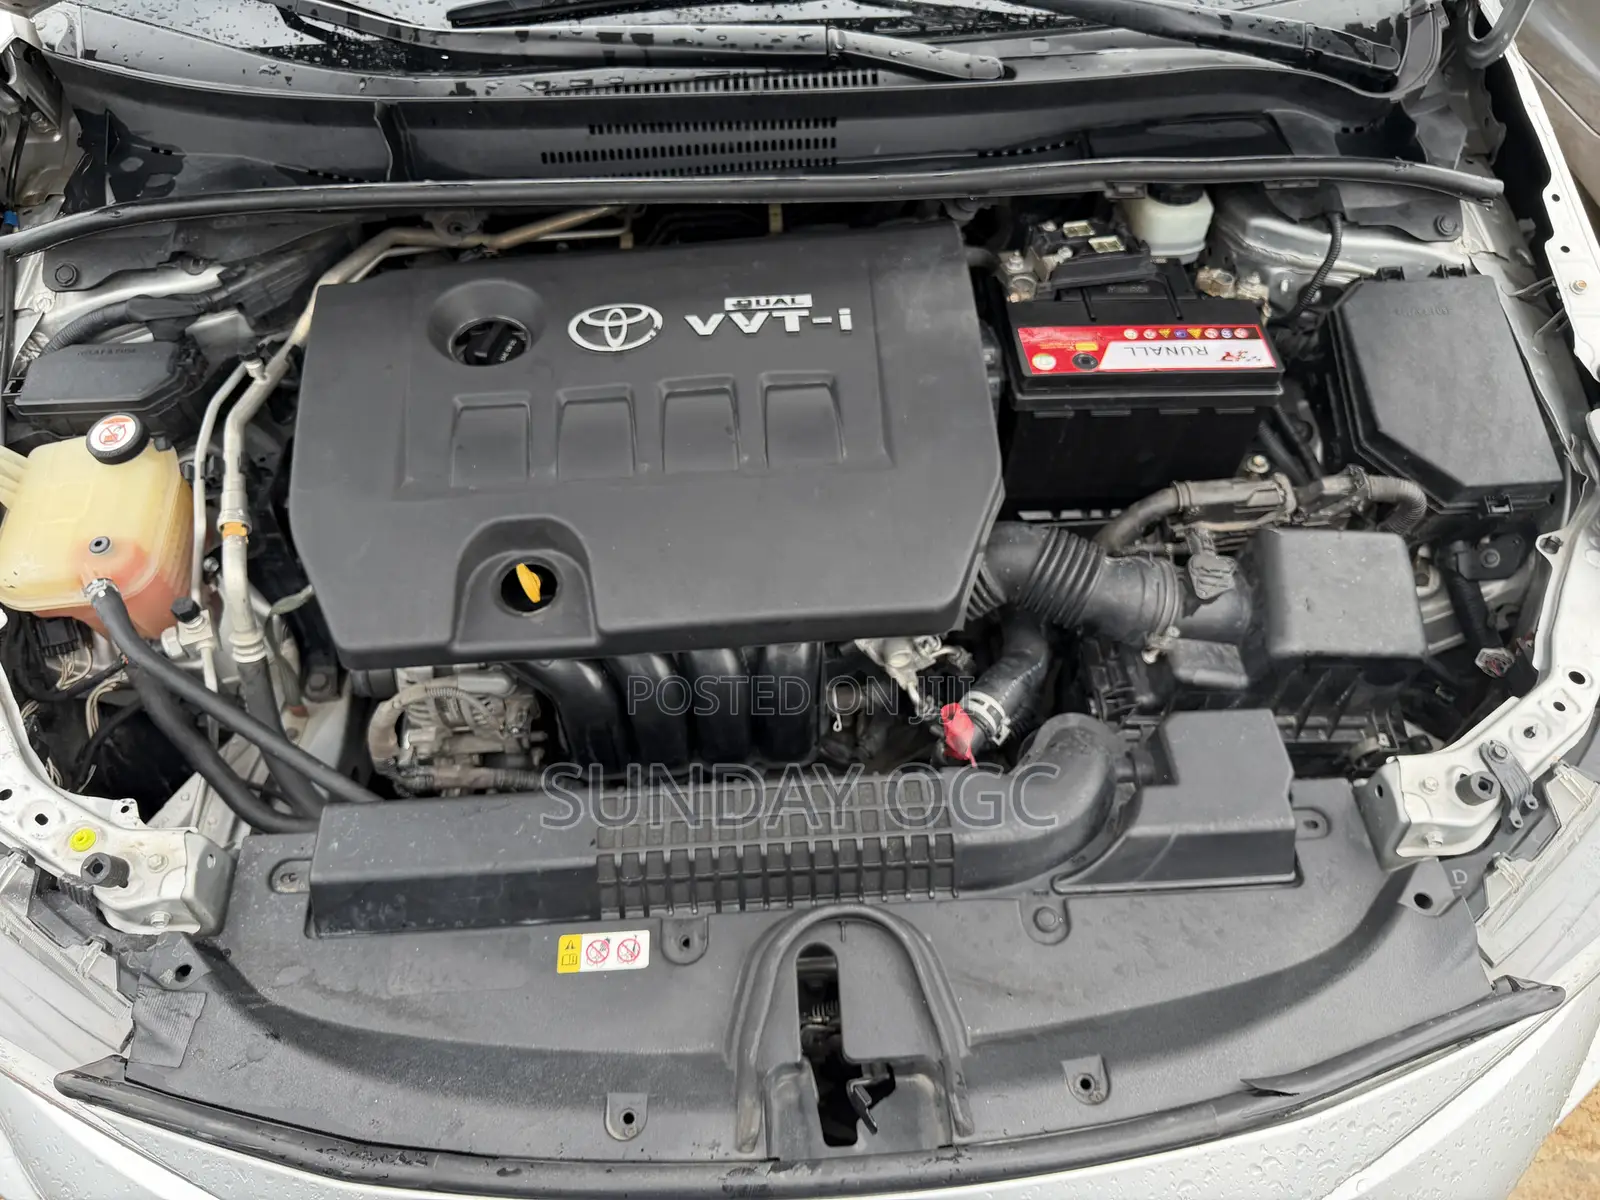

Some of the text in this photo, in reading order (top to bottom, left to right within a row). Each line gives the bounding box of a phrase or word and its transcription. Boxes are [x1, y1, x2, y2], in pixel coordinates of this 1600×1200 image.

[729, 295, 808, 310] DUAL
[684, 308, 853, 336] VVT-i
[1123, 345, 1209, 358] RUNALL
